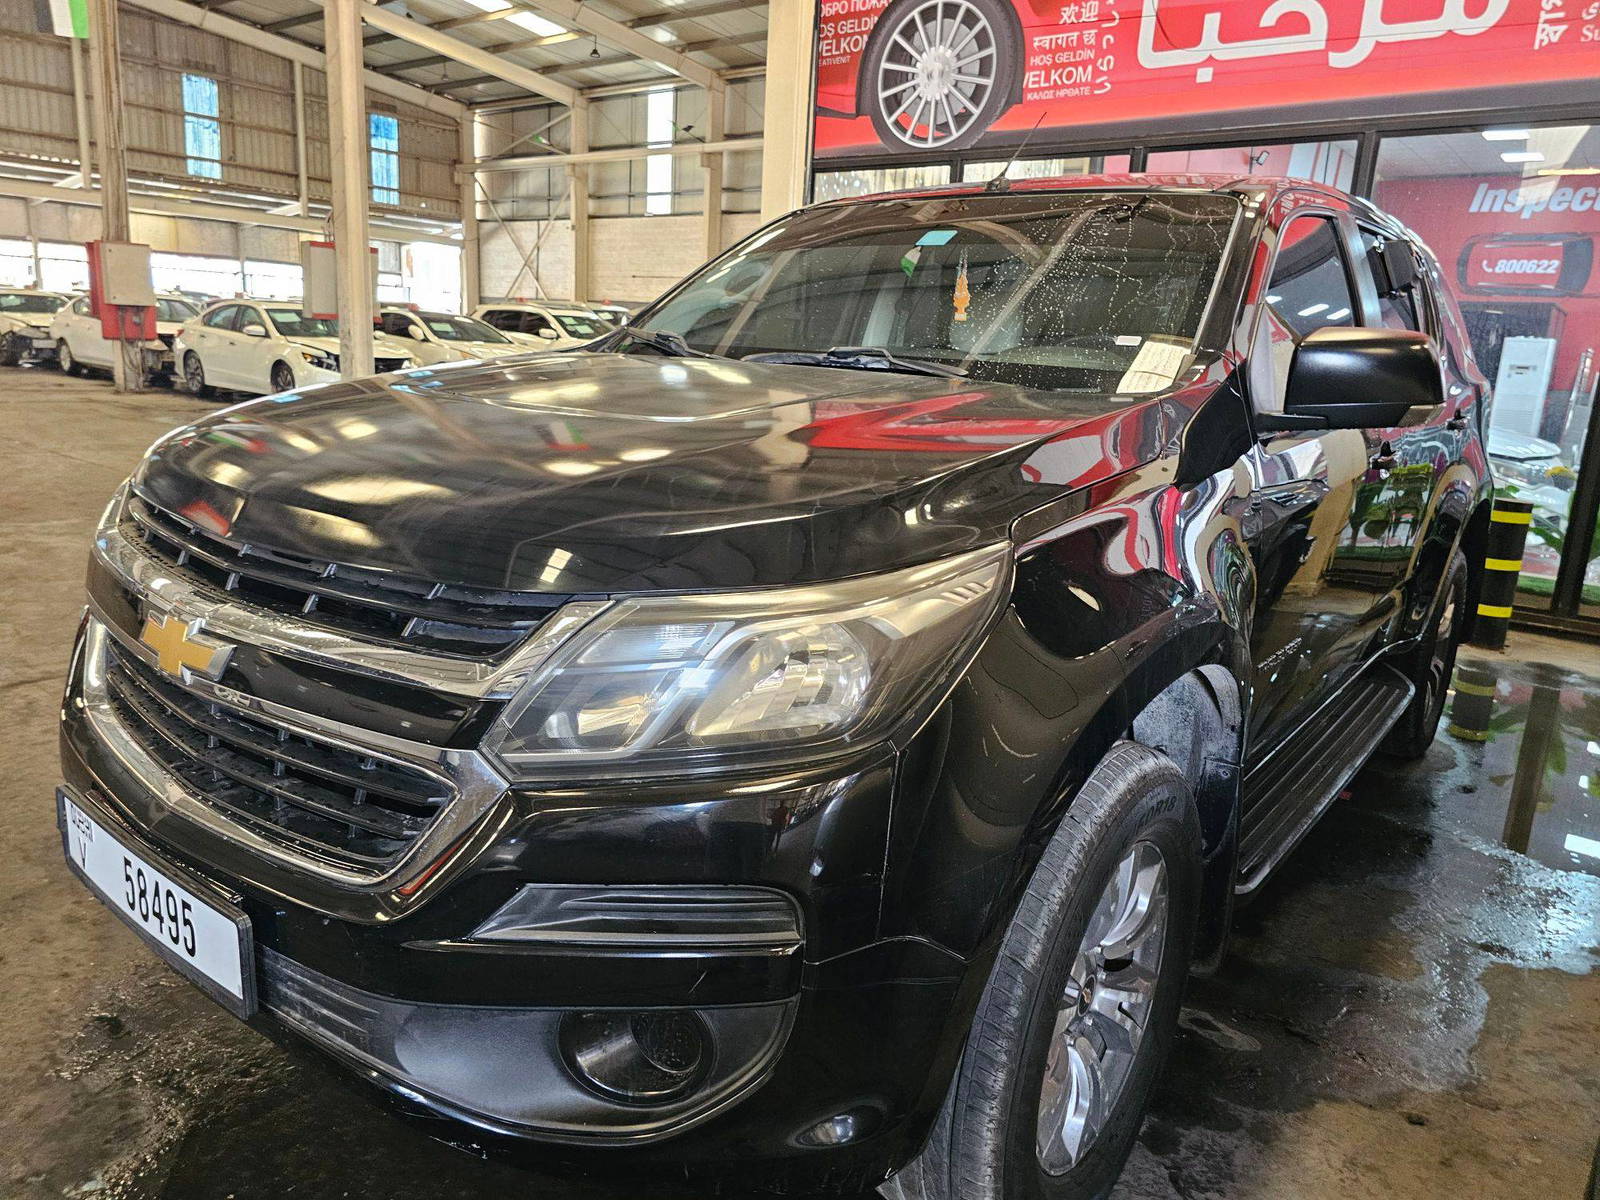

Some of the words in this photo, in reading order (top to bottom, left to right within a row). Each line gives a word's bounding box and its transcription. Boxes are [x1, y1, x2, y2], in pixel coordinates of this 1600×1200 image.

[1059, 1, 1099, 24] 欢迎
[819, 34, 868, 56] ELKO
[1033, 31, 1080, 51] स्वागत
[1093, 0, 1120, 94] いらっし
[1023, 64, 1092, 88] ELKOM
[1494, 259, 1561, 274] 800622
[78, 836, 87, 870] V
[123, 855, 197, 958] 58495
